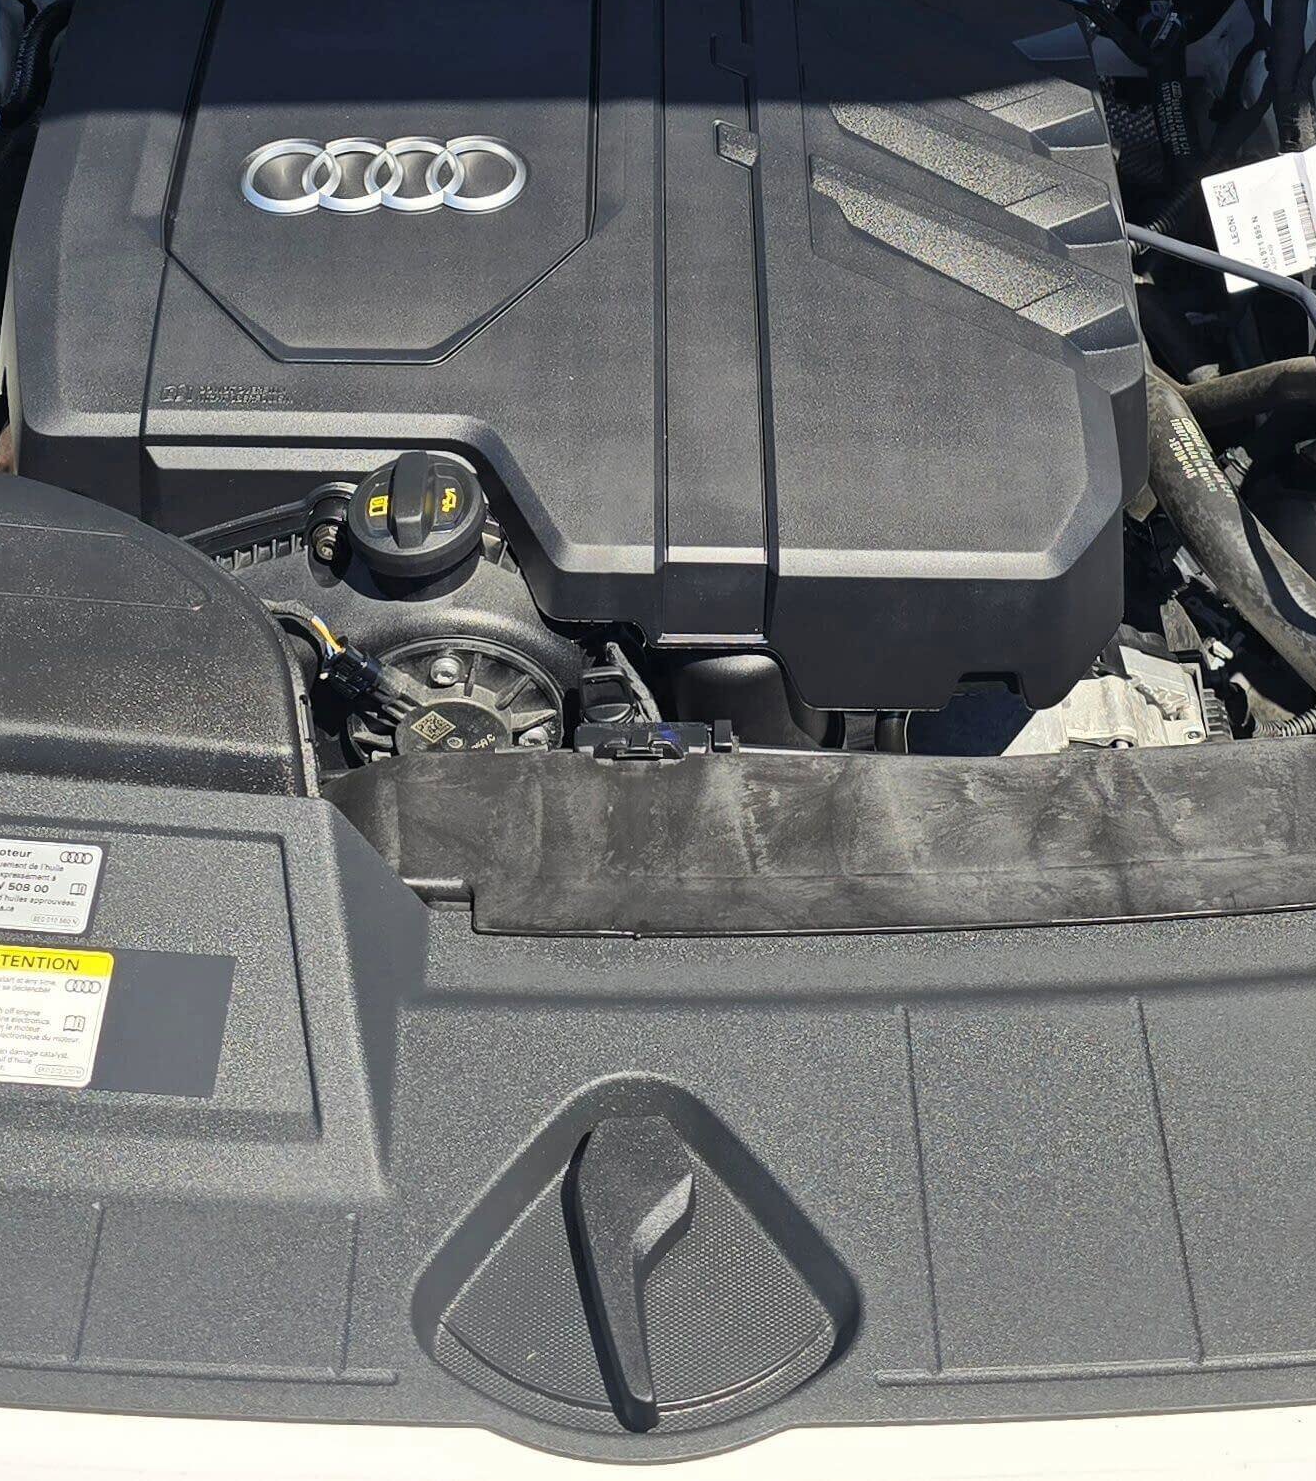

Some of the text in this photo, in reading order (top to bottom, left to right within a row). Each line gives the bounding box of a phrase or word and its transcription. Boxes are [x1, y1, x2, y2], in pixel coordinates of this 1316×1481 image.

[1227, 215, 1241, 245] LEONI
[8, 883, 30, 892] 508
[33, 884, 49, 893] 00
